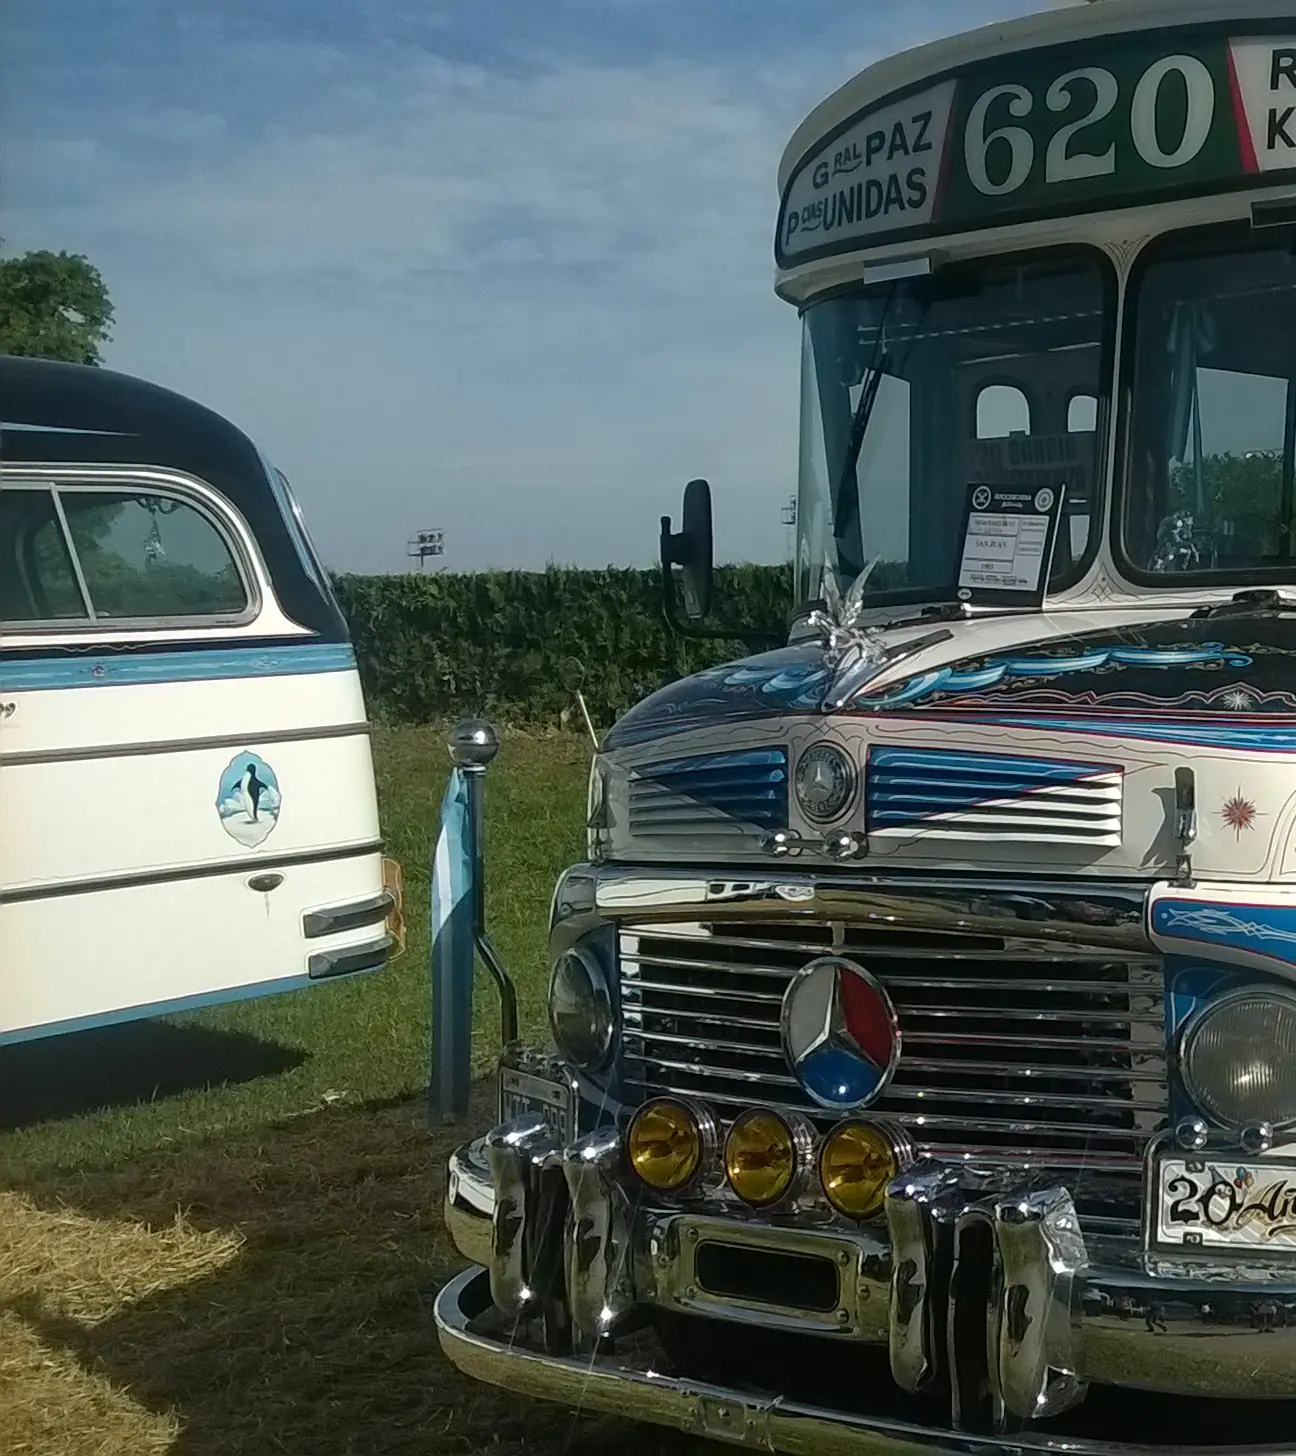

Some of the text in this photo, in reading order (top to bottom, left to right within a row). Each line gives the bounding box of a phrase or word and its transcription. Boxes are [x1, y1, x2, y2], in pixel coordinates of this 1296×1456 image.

[865, 109, 932, 167] PAZ
[963, 53, 1215, 197] 620
[823, 167, 928, 232] UNIDAS
[1167, 1174, 1243, 1226] 20
